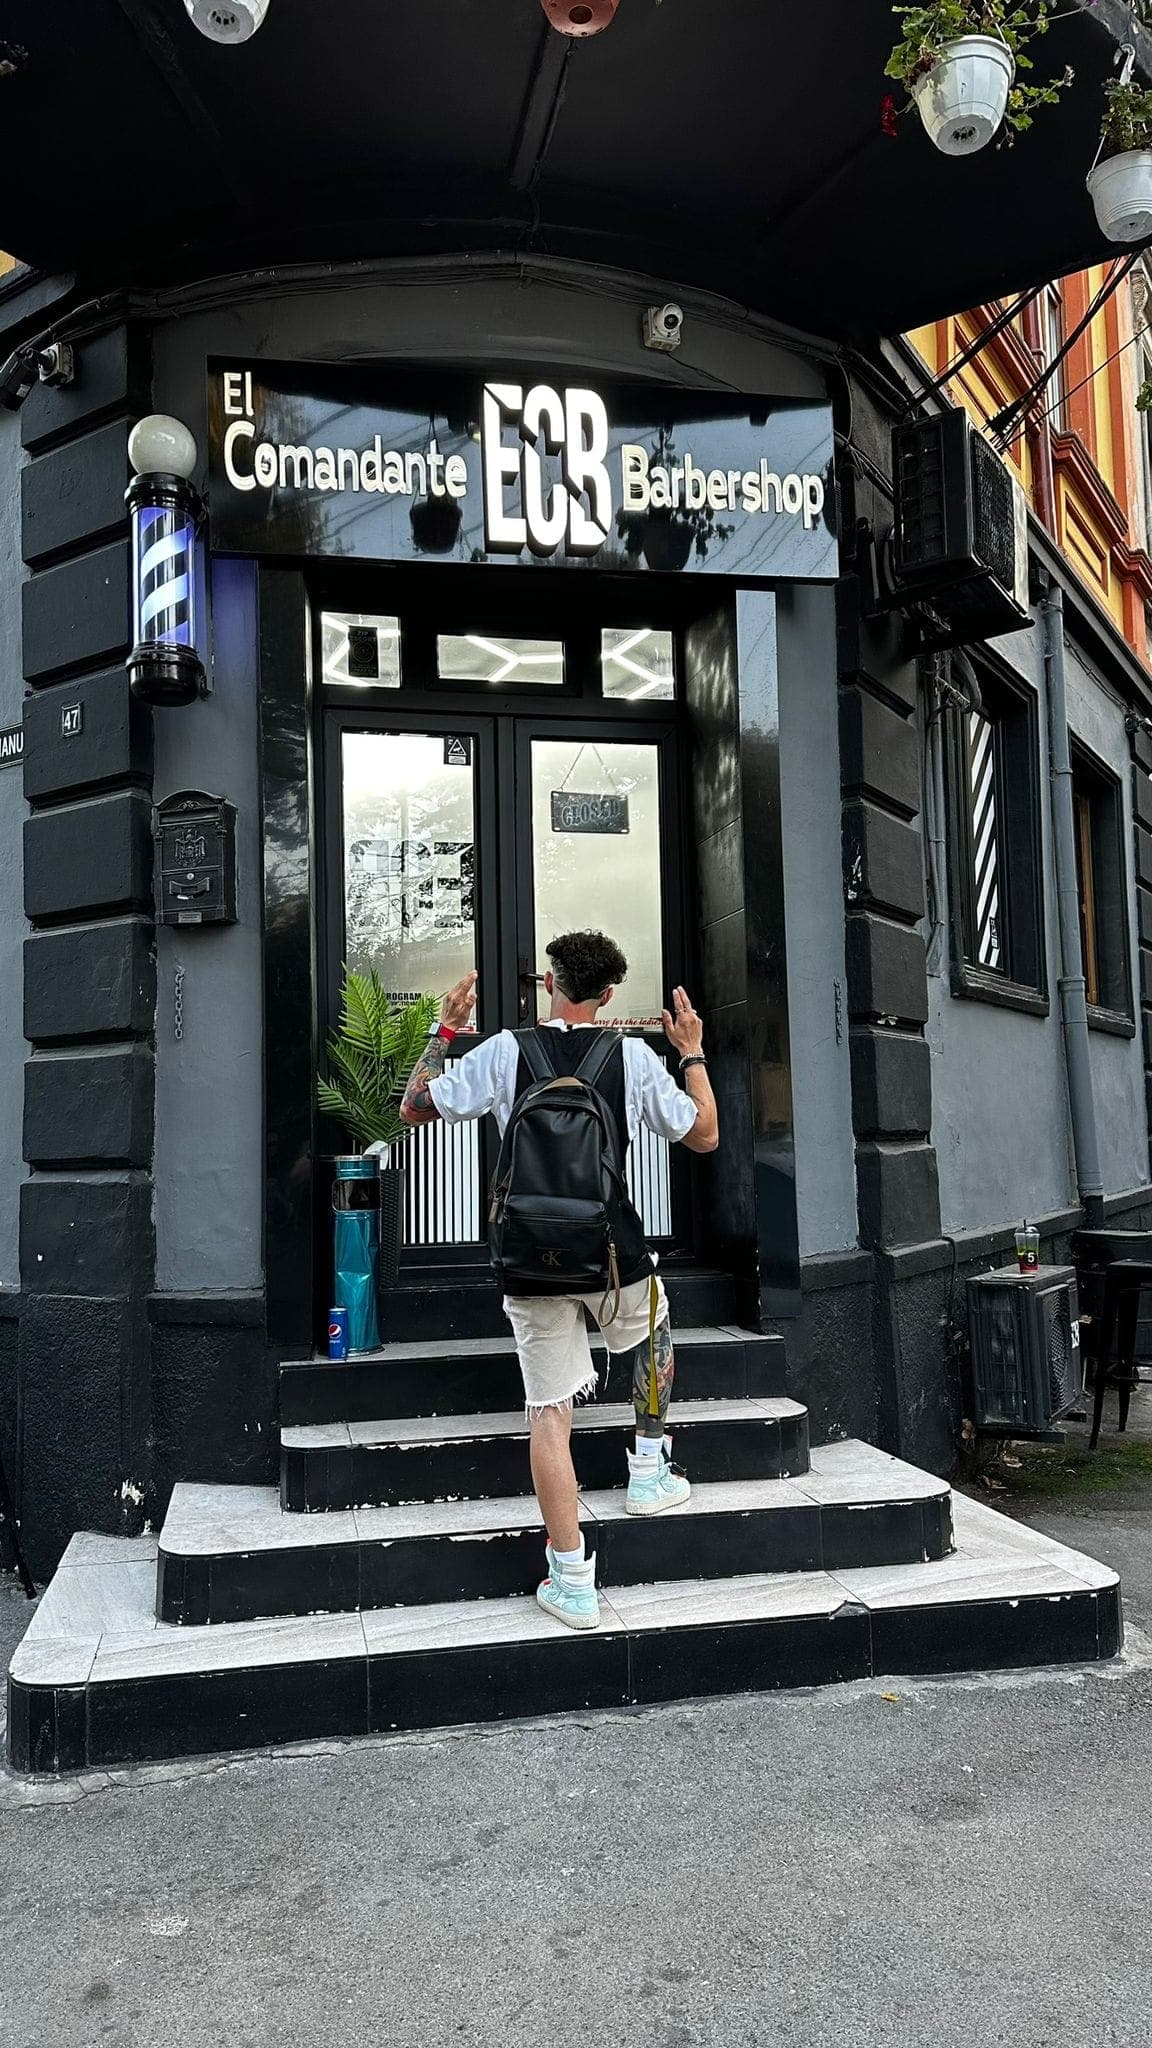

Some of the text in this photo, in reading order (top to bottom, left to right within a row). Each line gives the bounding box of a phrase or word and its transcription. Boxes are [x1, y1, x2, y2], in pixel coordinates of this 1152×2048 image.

[223, 371, 254, 416] El
[224, 420, 468, 497] Comandante
[483, 383, 612, 546] ECB
[621, 443, 825, 530] Barbershop
[64, 709, 78, 730] 47
[624, 1017, 638, 1026] the
[1027, 1251, 1035, 1263] 5
